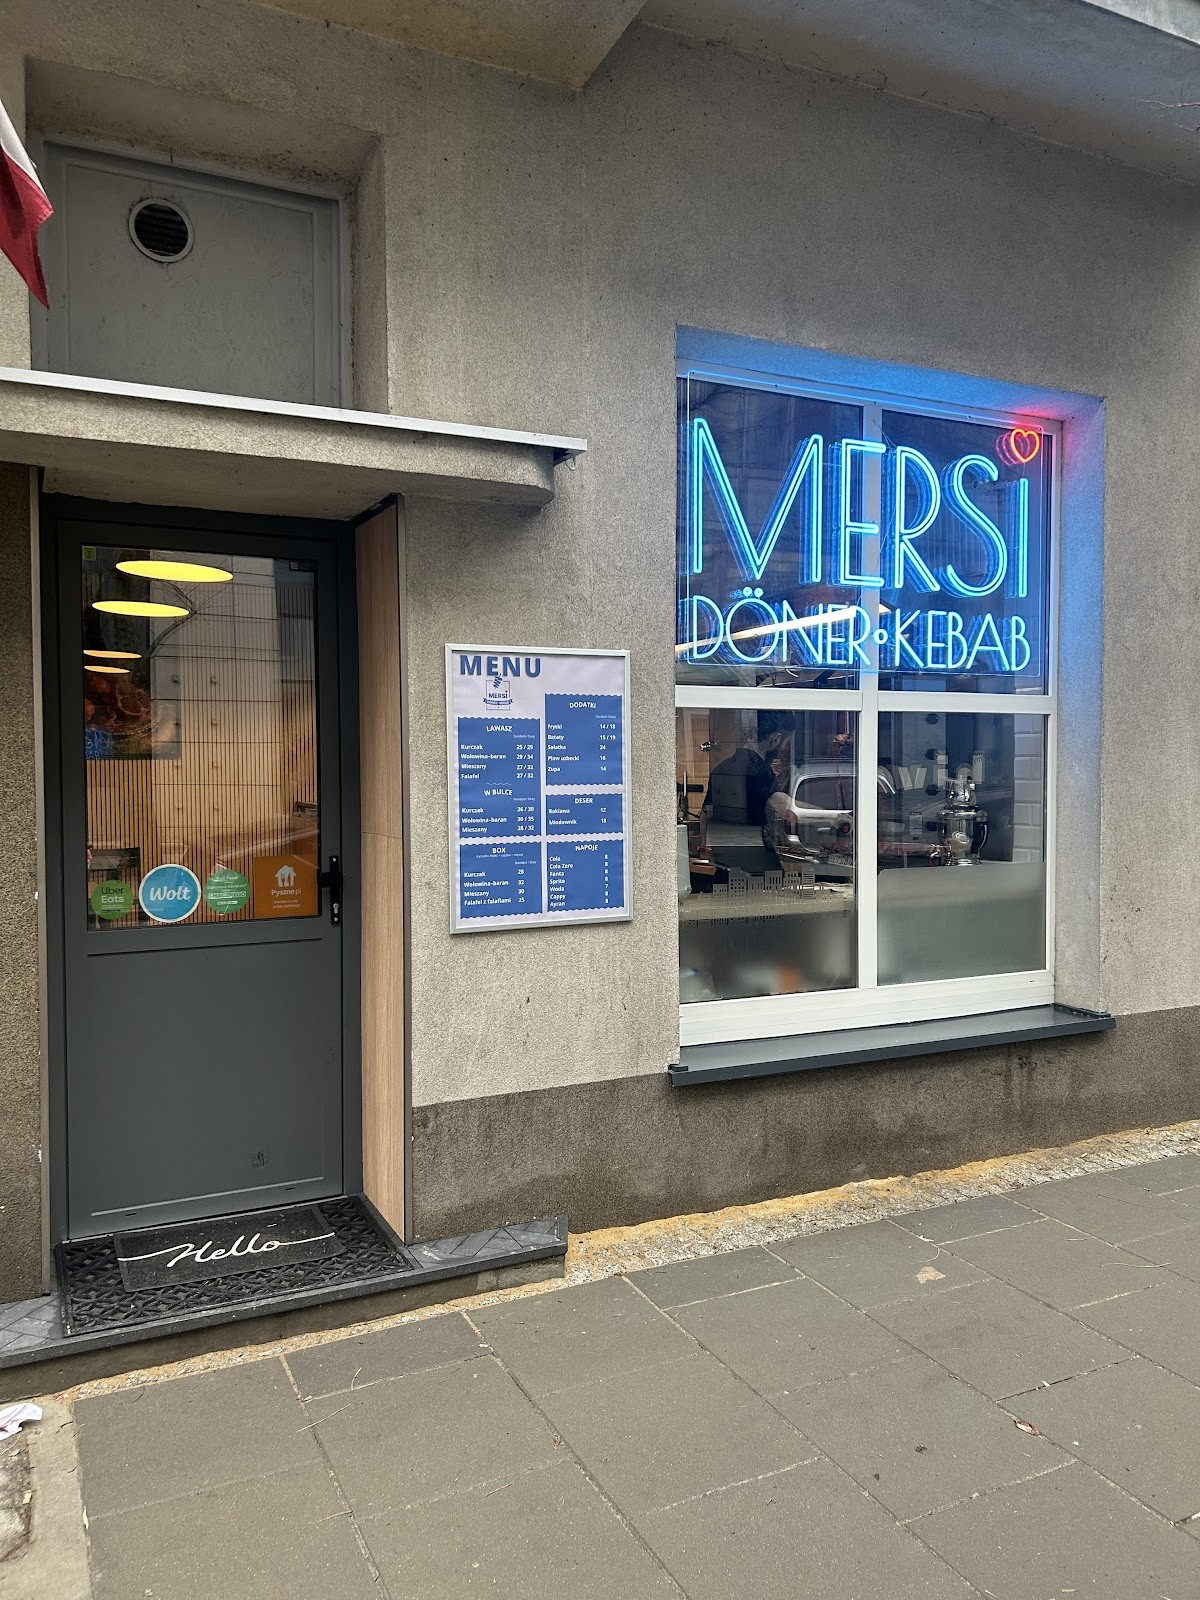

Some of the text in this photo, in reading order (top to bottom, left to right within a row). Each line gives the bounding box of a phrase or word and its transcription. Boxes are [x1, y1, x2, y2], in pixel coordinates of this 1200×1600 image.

[692, 588, 1031, 671] DÖNER KEBAB
[460, 655, 540, 678] MENU
[101, 886, 124, 894] Uber
[149, 885, 191, 901] Wolt
[101, 895, 125, 903] Eats
